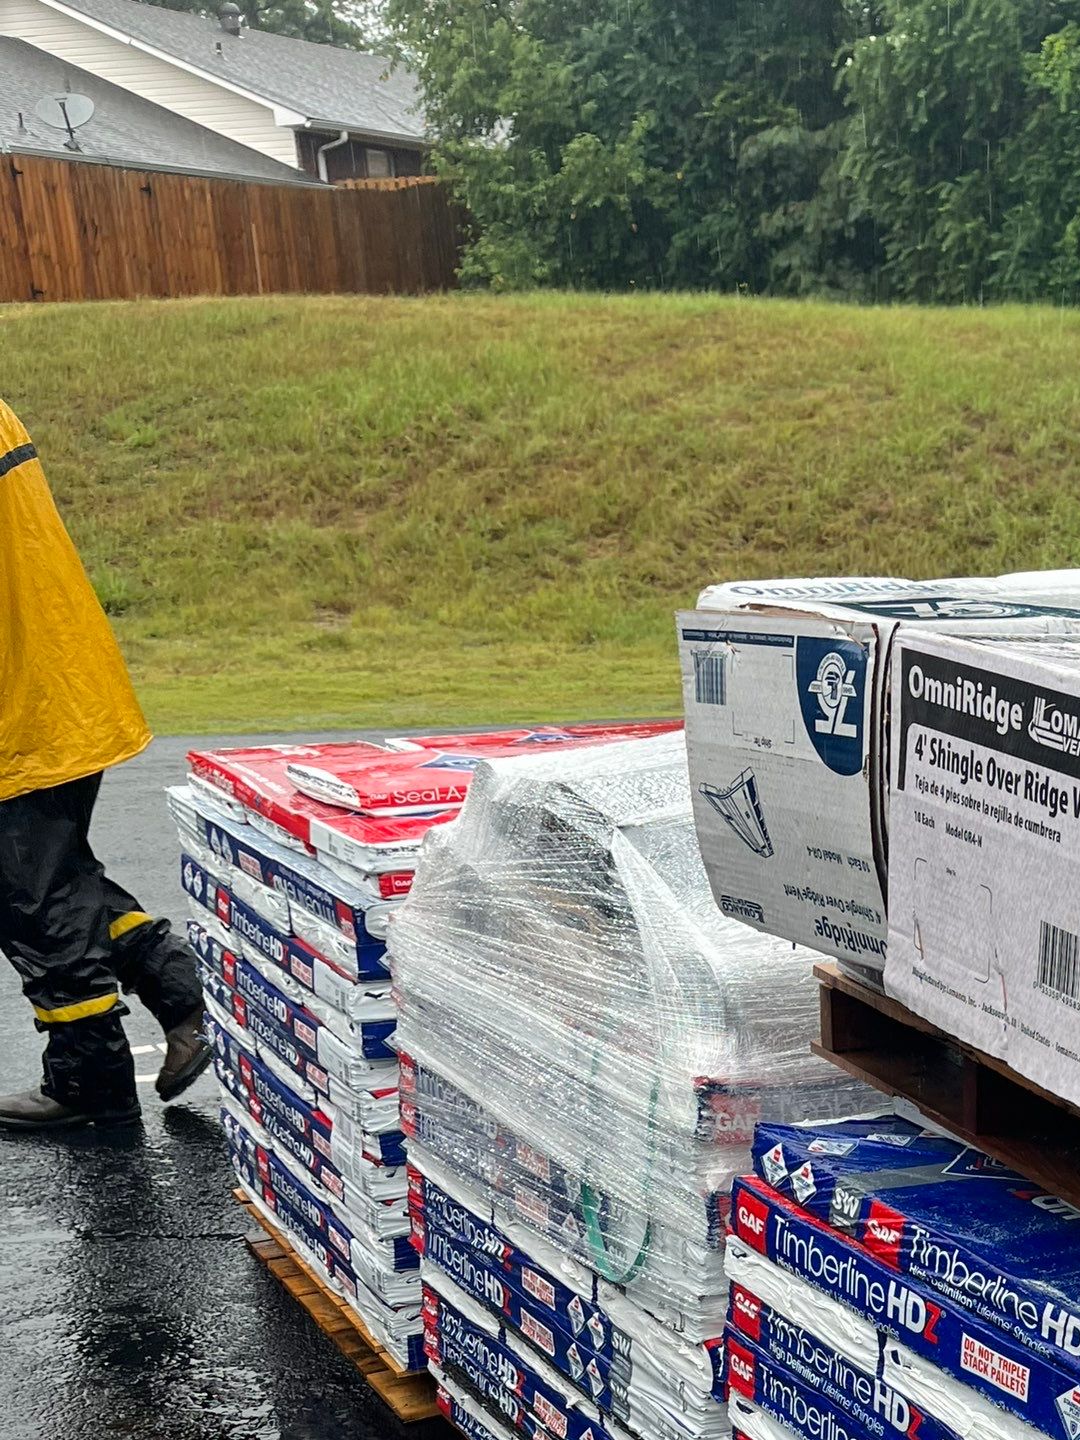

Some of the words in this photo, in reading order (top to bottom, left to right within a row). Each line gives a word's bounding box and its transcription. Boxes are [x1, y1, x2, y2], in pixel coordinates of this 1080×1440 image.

[908, 665, 1023, 735] OmniRidge
[914, 733, 927, 761] 4'
[929, 737, 983, 786] Shingle
[986, 757, 1021, 796] Over
[1024, 770, 1068, 818] Ridge
[915, 774, 929, 795] Teja
[930, 780, 939, 795] de
[940, 784, 946, 798] 4
[945, 786, 960, 804] pies
[960, 790, 981, 811] sobre
[982, 798, 990, 815] la
[990, 802, 1012, 824] rejilla
[1013, 811, 1024, 827] de
[1024, 818, 1062, 843] cumbrera
[783, 883, 804, 902] Vent
[804, 887, 825, 907] Ridge
[825, 895, 845, 912] Over
[845, 899, 874, 922] Shingle
[833, 1187, 860, 1218] SW
[738, 1206, 765, 1235] GAF
[773, 1214, 885, 1313] Timberline
[886, 1280, 942, 1344] HDZ
[909, 1224, 1039, 1330] Timberline
[731, 1354, 754, 1381] GAF
